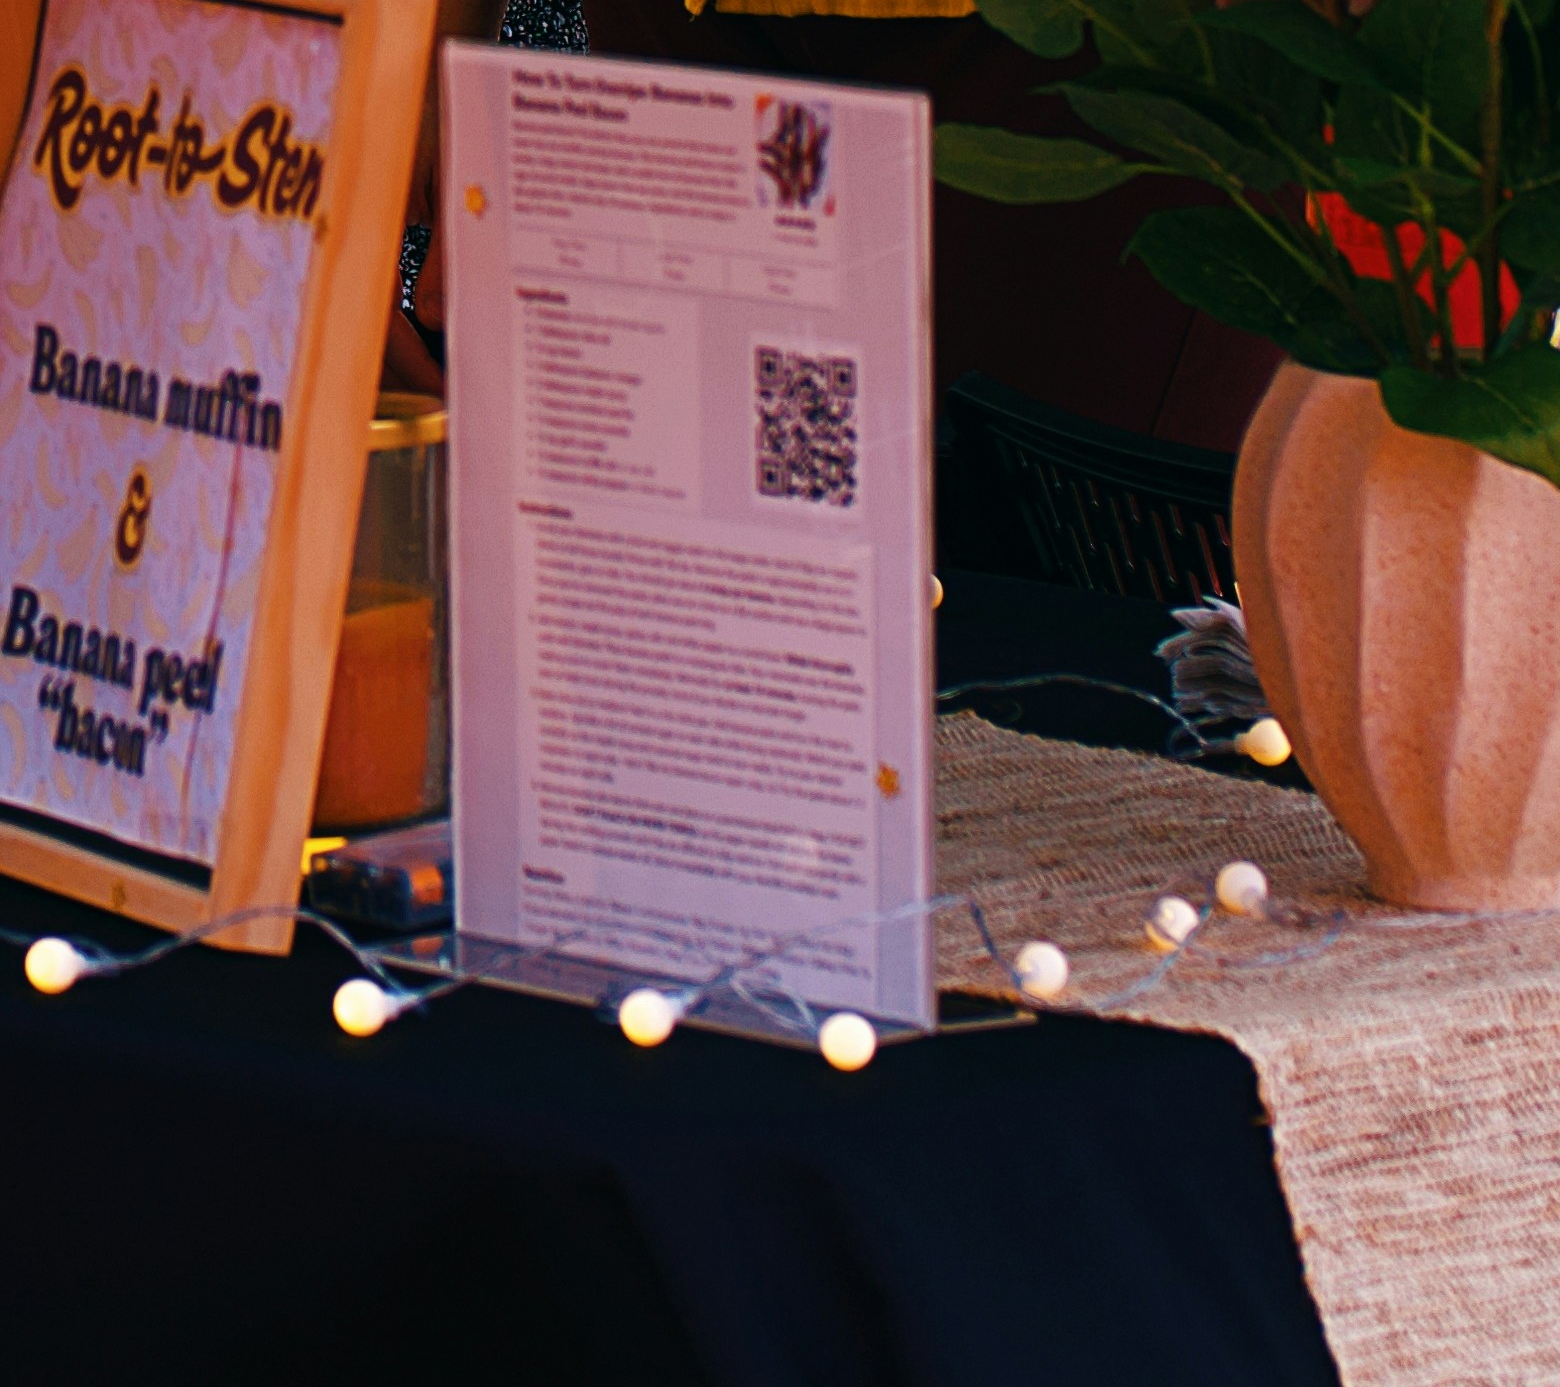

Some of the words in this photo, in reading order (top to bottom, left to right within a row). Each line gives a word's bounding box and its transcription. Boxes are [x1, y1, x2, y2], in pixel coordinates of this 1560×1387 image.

[29, 323, 159, 421] Banana
[164, 369, 282, 452] muffin
[114, 467, 153, 569] &
[1, 585, 136, 690] Banana
[138, 638, 225, 716] peel
